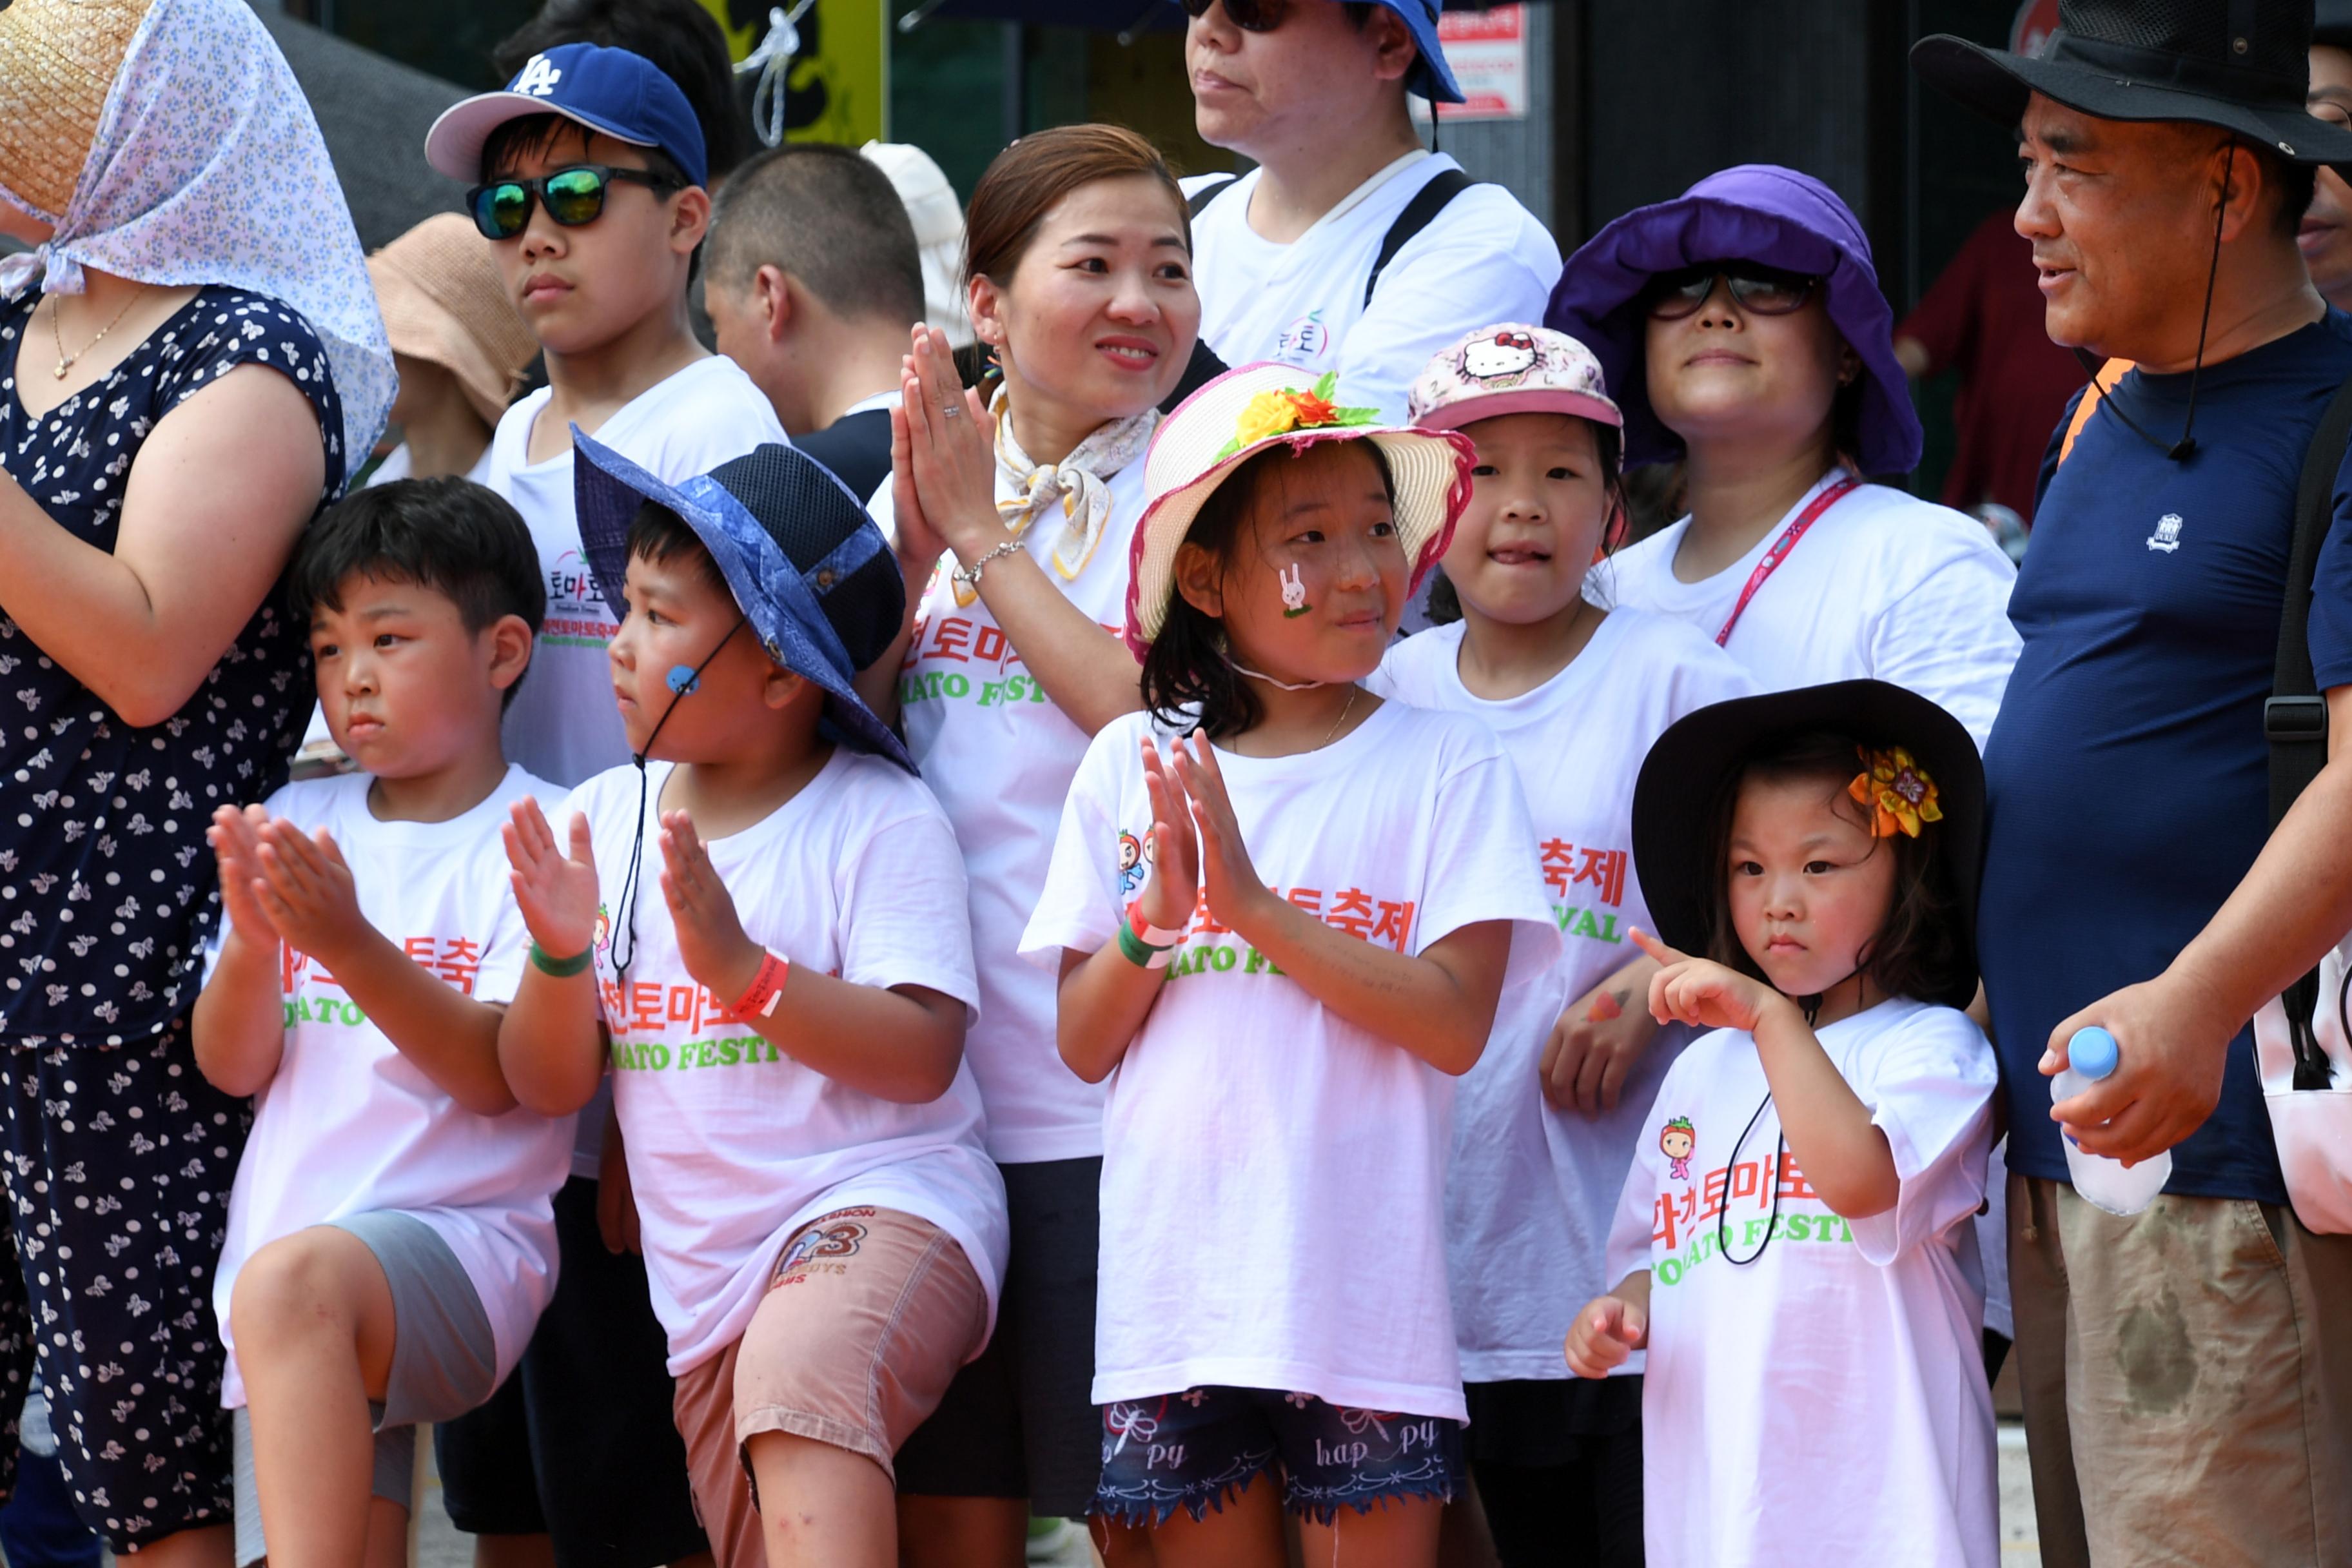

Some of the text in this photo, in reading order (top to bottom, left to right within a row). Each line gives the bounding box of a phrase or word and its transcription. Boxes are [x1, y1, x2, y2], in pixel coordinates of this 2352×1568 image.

[513, 54, 562, 95] LA
[1540, 838, 1627, 907] 축제
[1551, 904, 1622, 945] VAL
